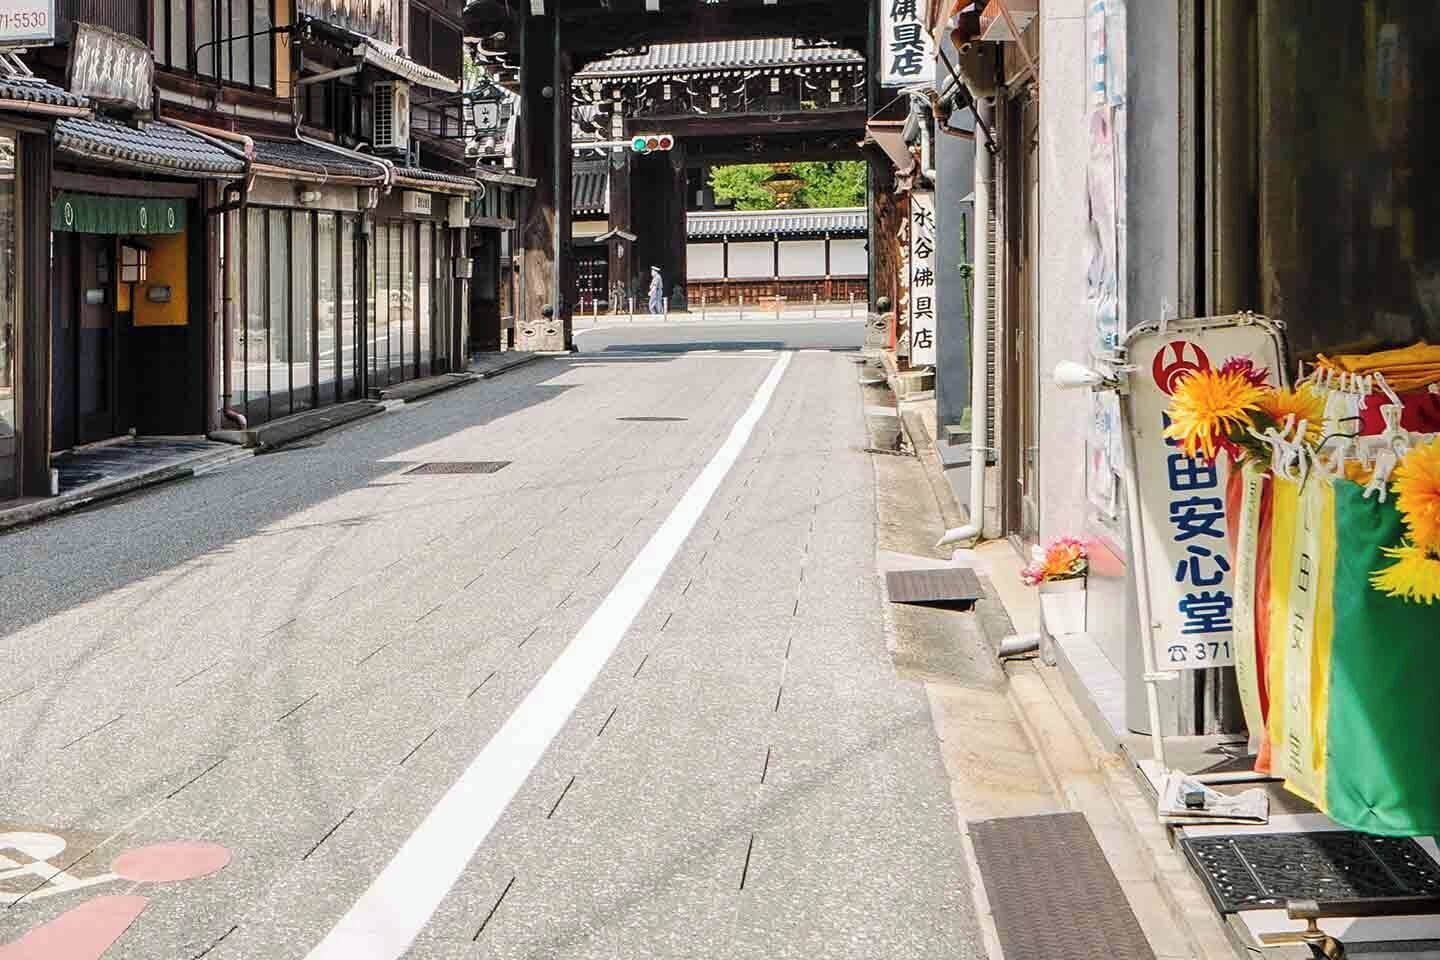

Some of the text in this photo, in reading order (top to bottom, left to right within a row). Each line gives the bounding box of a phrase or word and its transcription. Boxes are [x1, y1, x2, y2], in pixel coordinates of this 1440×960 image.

[913, 207, 934, 350] 水谷佛具店
[1162, 411, 1234, 635] 田安心堂
